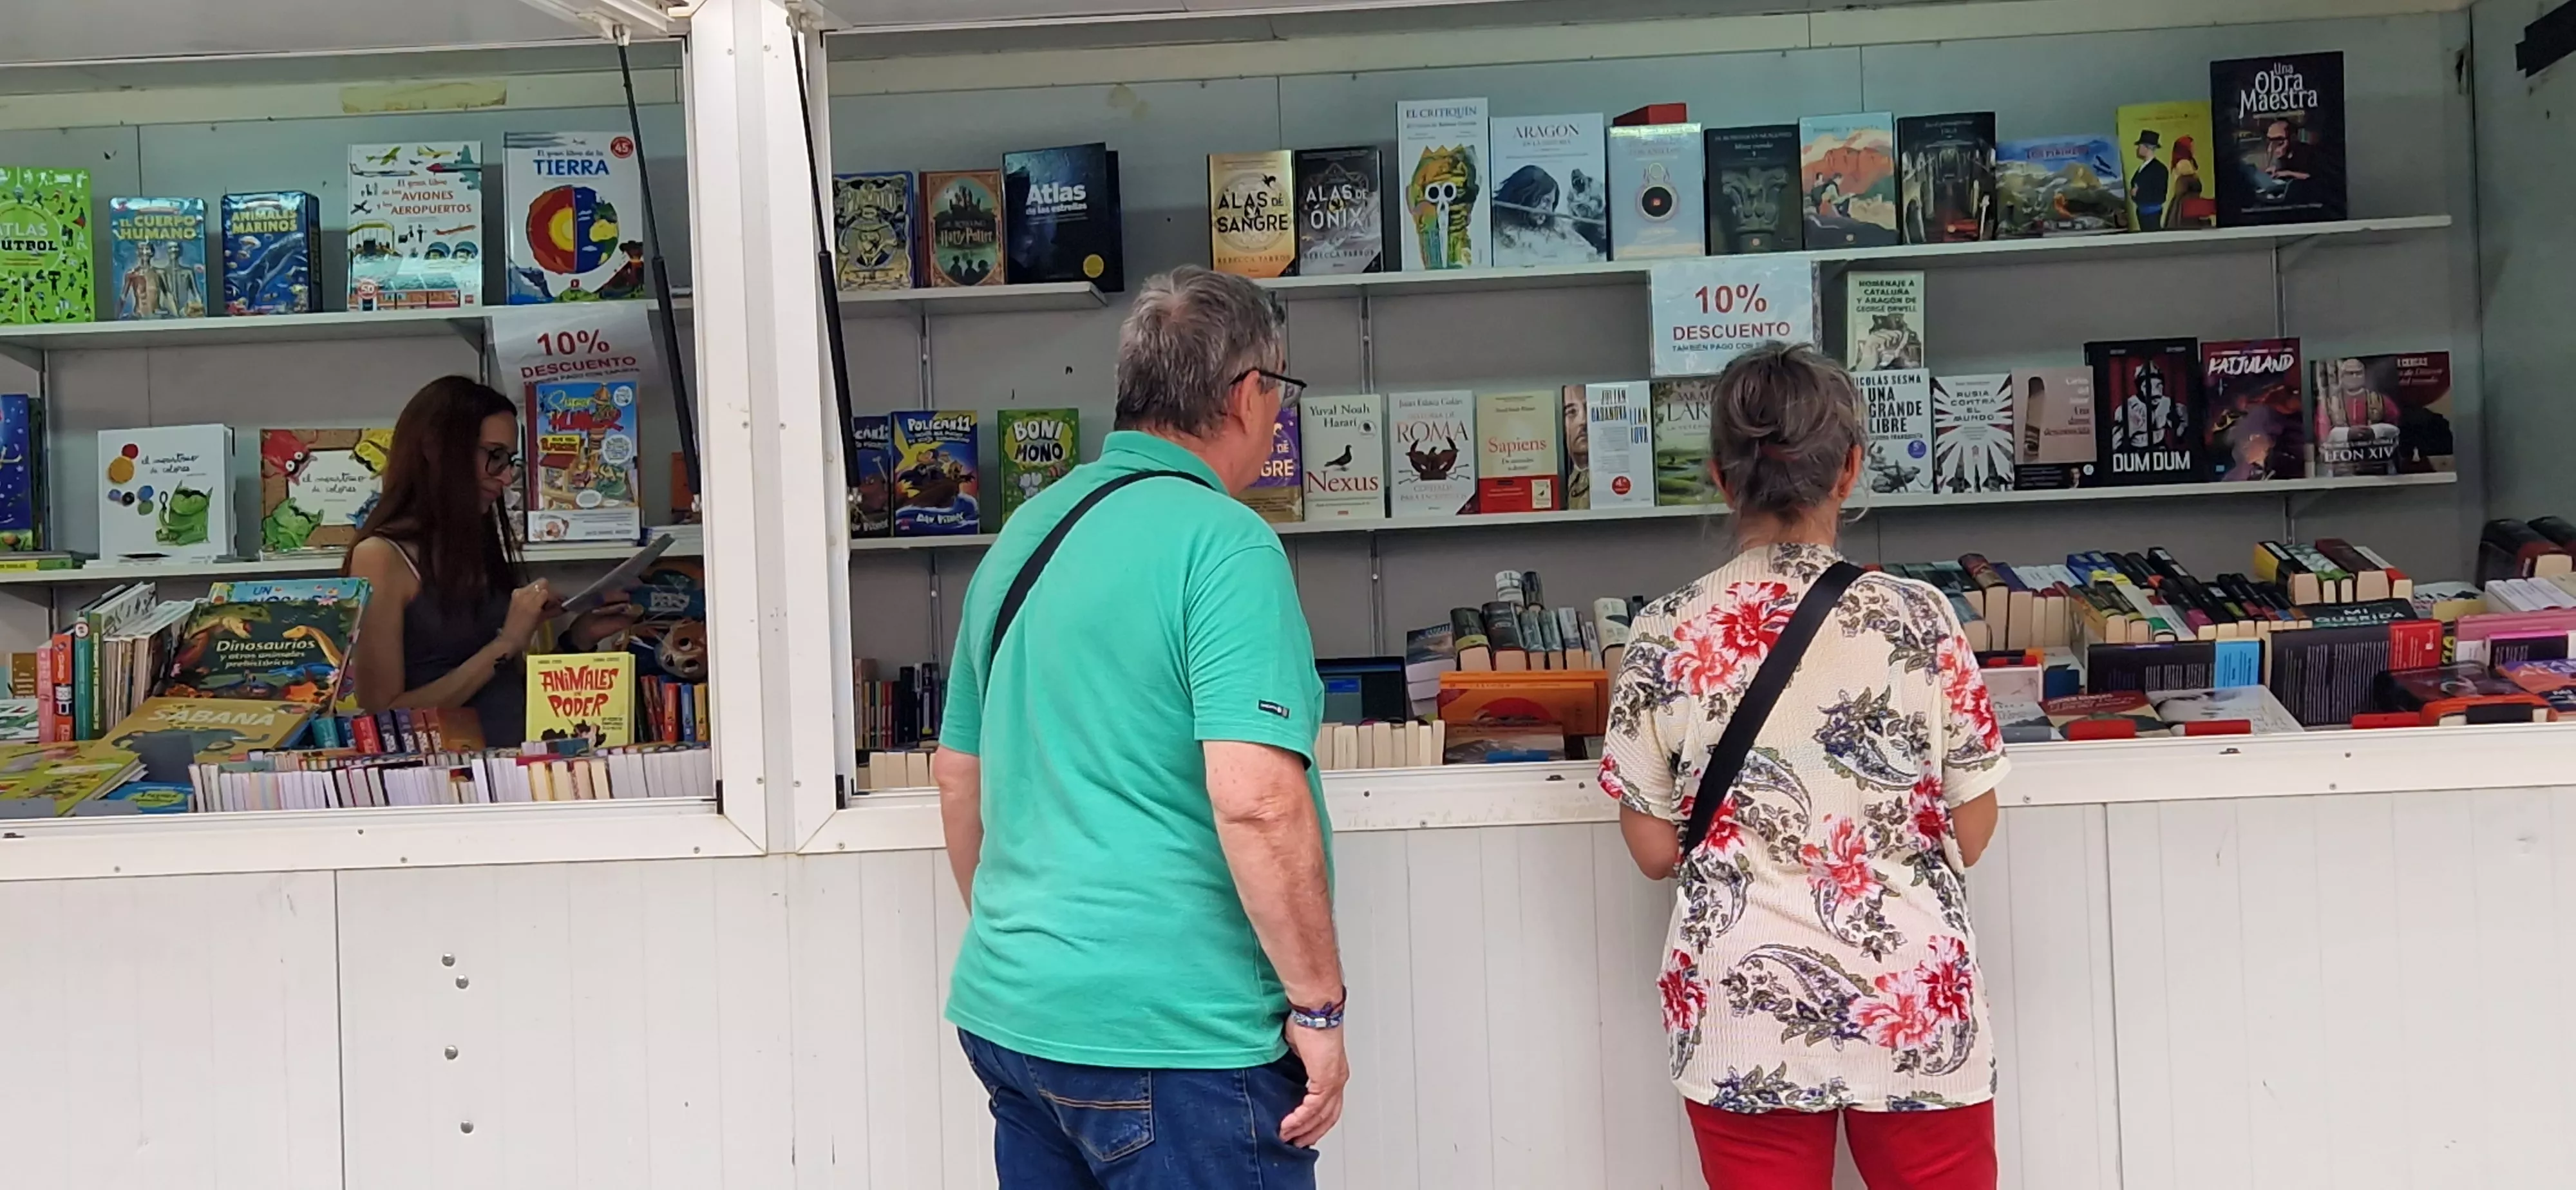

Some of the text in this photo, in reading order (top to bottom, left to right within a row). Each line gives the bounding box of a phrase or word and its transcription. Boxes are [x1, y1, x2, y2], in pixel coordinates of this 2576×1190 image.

[2274, 62, 2293, 75] Una
[2255, 71, 2303, 93] Obra
[2239, 89, 2318, 118] Maestra
[1406, 109, 1417, 118] EL
[614, 142, 629, 153] 45
[533, 158, 610, 176] TIERRA
[401, 190, 454, 201] AVIONES
[1026, 182, 1087, 205] Atlas
[1217, 191, 1268, 211] ALAS
[1305, 184, 1368, 203] ALAS DE
[232, 207, 298, 222] ANIMALES
[390, 203, 473, 215] AEROPUERTOS
[1037, 205, 1050, 214] las
[1051, 202, 1088, 213] estrellas
[133, 215, 196, 227] CUERPO
[1216, 213, 1289, 234] SANGRE
[1311, 204, 1363, 230] ÓNIX
[120, 227, 196, 240] HUMANO
[232, 220, 298, 234] MARINOS
[0, 236, 59, 251] ÚTBOL
[940, 227, 993, 248] Harry Potter
[1859, 279, 1906, 288] HOMENAJE
[1694, 283, 1768, 314] 10%
[1672, 321, 1791, 341] DESCUENTO
[536, 328, 610, 357] 10%
[520, 355, 637, 379] DESCUENTO
[2207, 354, 2295, 377] KAIJULAND
[1891, 373, 1922, 385] SESMA
[1868, 386, 1895, 402] UNA
[1950, 397, 1996, 406] CONTRA
[1956, 390, 1989, 398] RUSIA
[1309, 402, 1370, 417] Yuval Noah
[1667, 401, 1710, 422] LAR
[1869, 400, 1923, 418] GRANDE
[1013, 419, 1064, 442] BONI
[1323, 417, 1357, 428] Harari
[1868, 417, 1908, 433] LIBRE
[1396, 419, 1470, 444] ROMA
[1014, 442, 1064, 462] MONO
[1488, 436, 1548, 458] Sapiens
[2368, 446, 2394, 460] XIV
[1260, 458, 1295, 477] GRE
[2112, 450, 2191, 473] DUM DUM
[1305, 470, 1379, 494] Nexus
[252, 585, 273, 596] UN
[2313, 612, 2407, 624] QUERIDA
[2343, 608, 2369, 616] MI
[216, 639, 317, 652] Dinosaurios
[258, 650, 306, 659] animales
[225, 659, 294, 670] prehistóricos
[547, 693, 609, 718] PODER
[147, 708, 276, 726] SABANA
